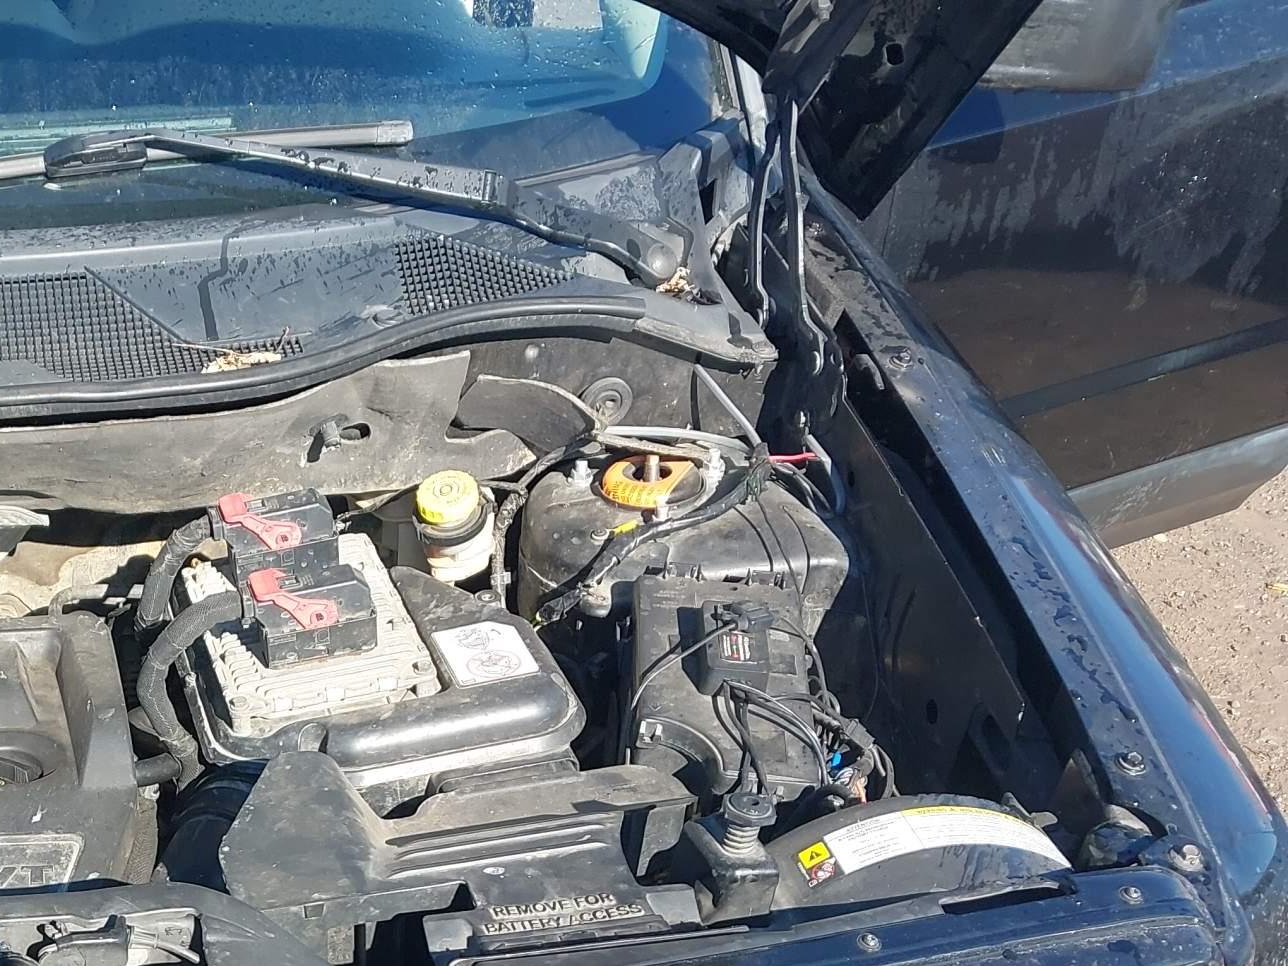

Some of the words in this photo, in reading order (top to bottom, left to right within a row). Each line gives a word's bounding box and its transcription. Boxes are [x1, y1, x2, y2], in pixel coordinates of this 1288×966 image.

[490, 899, 570, 918] REMOVE
[574, 892, 615, 909] FOR
[483, 915, 561, 935] BATTERY
[569, 904, 643, 925] ACCESS
